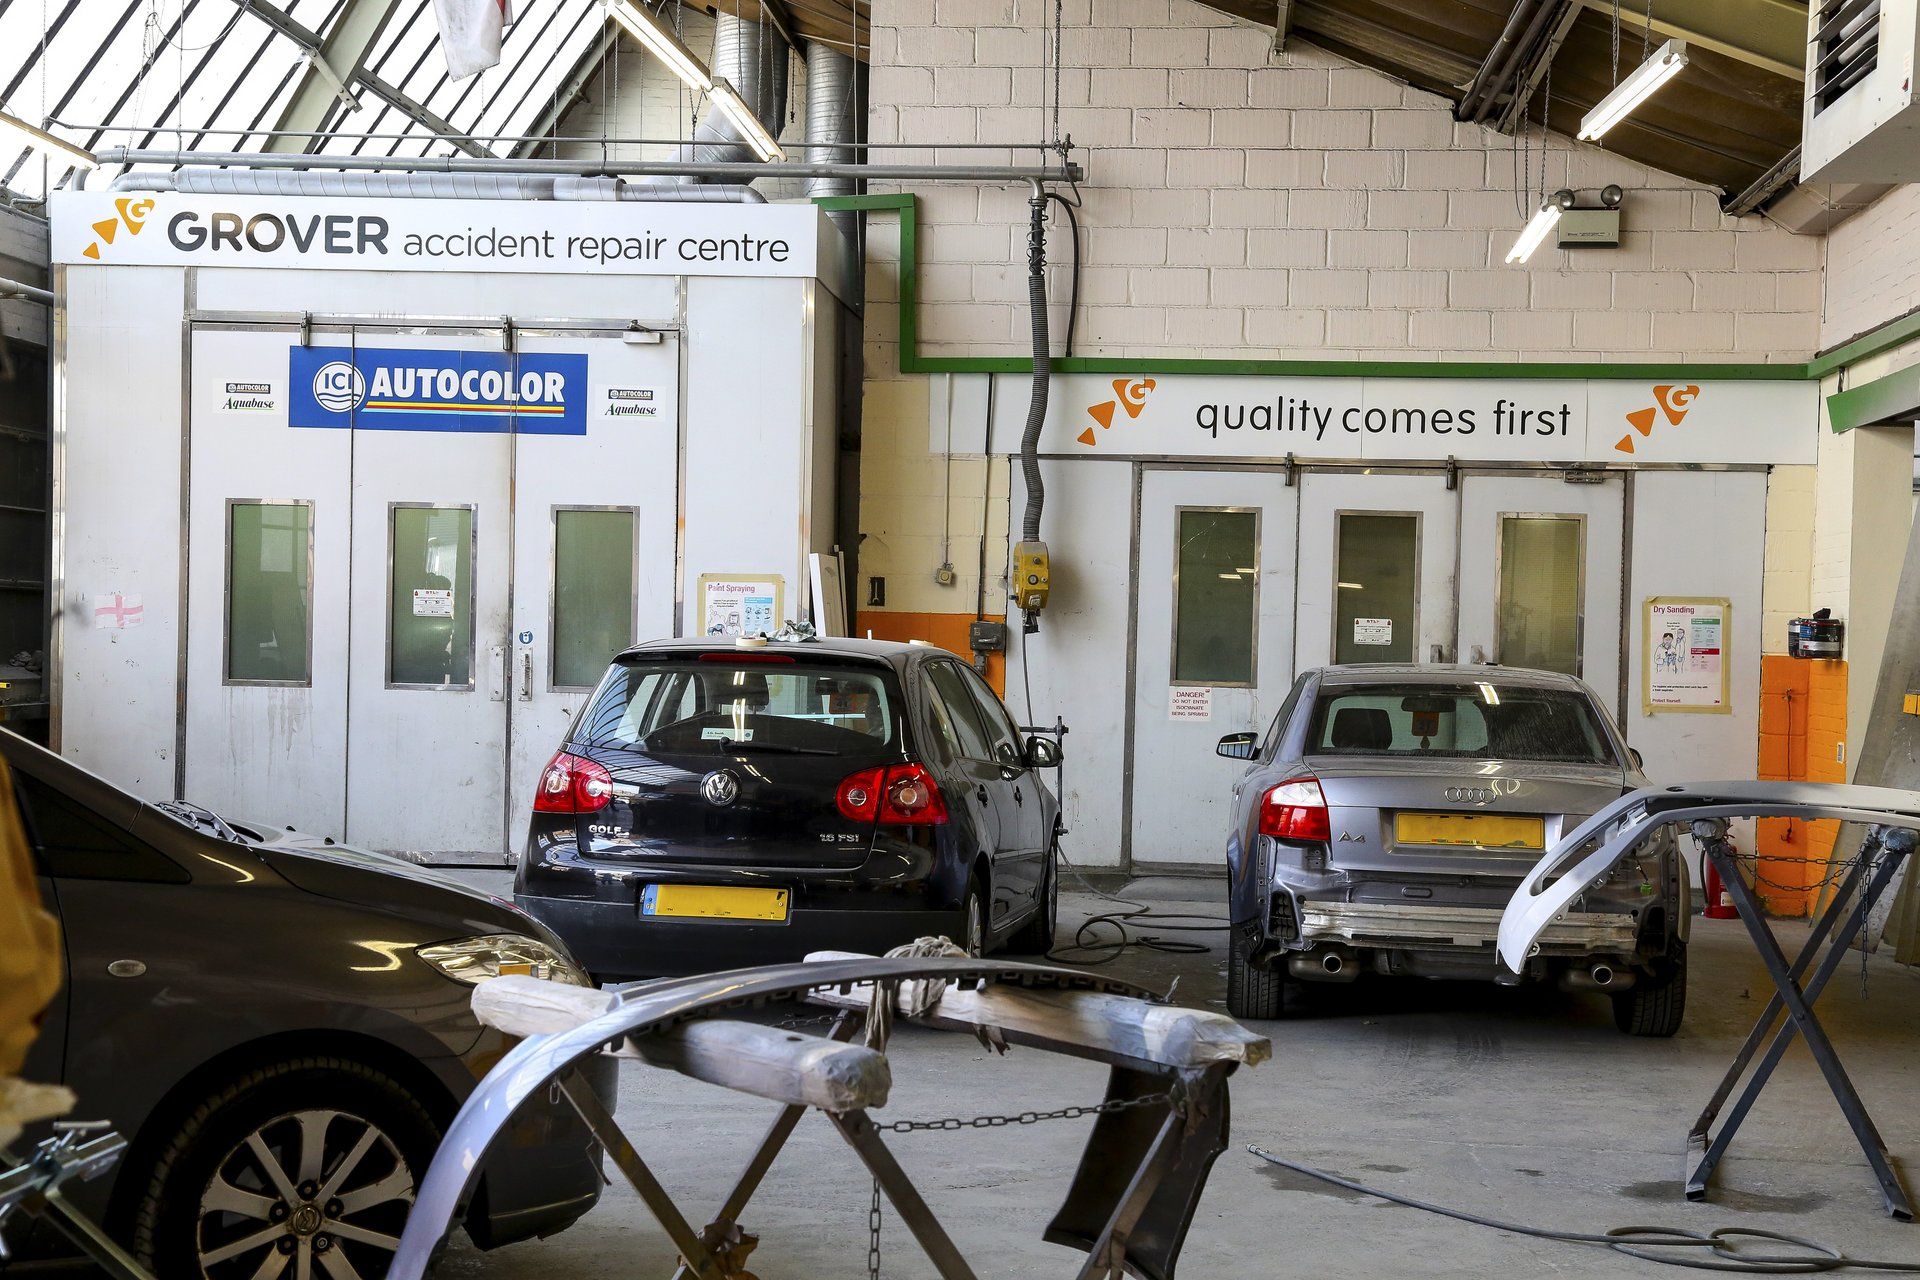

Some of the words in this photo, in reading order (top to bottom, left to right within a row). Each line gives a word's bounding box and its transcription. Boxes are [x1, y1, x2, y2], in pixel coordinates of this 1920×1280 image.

[167, 211, 389, 255] GROVER
[403, 227, 555, 259] accident
[567, 230, 667, 266] repair
[678, 233, 790, 263] centre
[323, 372, 354, 391] ICI
[370, 367, 566, 403] AUTOCOLOR
[222, 396, 275, 410] Aquabase
[604, 403, 657, 416] Aquabase
[1196, 395, 1333, 441] quality
[1342, 405, 1476, 435] comes
[1493, 399, 1571, 436] first
[708, 584, 725, 592] Paint
[726, 585, 756, 594] Spraying
[1653, 606, 1665, 614] Dry
[1667, 606, 1695, 614] Sanding
[588, 824, 622, 835] GOLF
[837, 833, 860, 843] FSI
